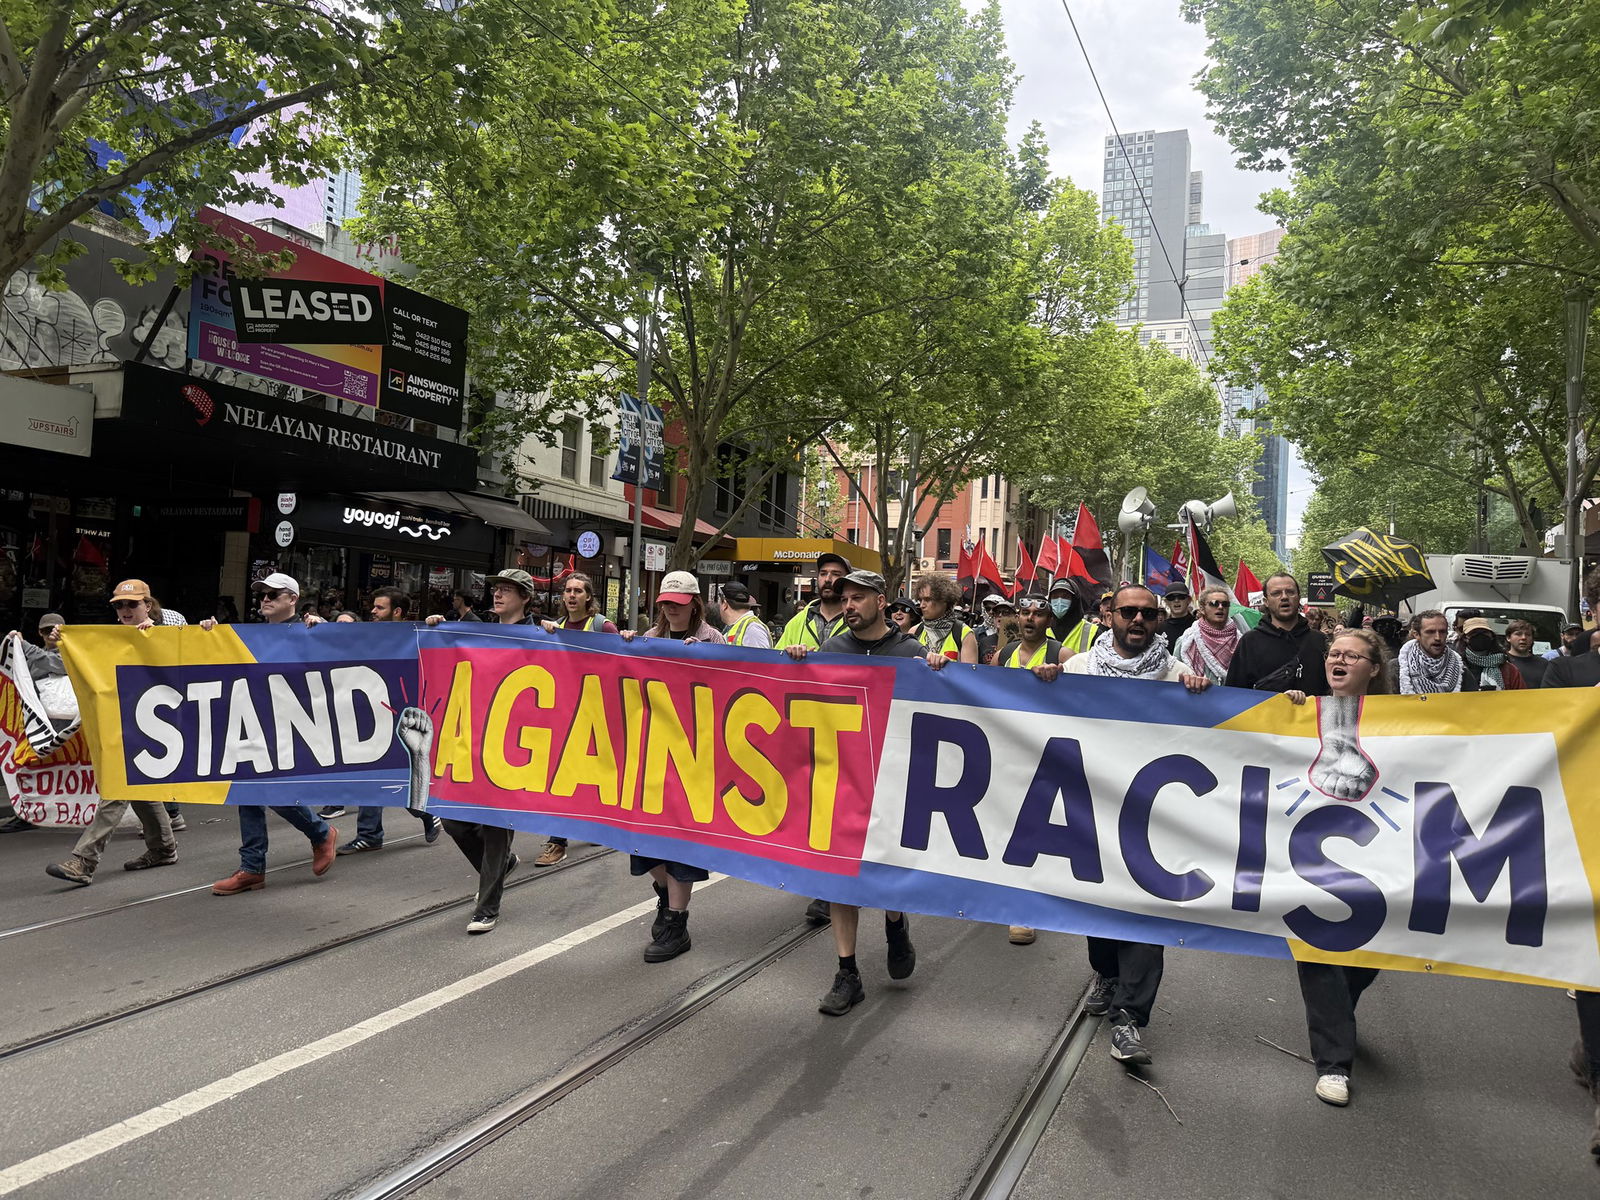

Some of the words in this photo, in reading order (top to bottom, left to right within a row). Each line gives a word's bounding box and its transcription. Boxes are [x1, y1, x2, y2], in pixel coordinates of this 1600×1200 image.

[203, 280, 232, 307] FO
[240, 287, 373, 322] LEASED
[393, 307, 410, 319] CALL
[411, 313, 421, 323] OR
[422, 317, 438, 329] TEXT
[392, 331, 406, 341] Josh
[415, 331, 430, 341] 0422
[430, 337, 440, 345] 510
[392, 339, 412, 352] Zelman
[216, 347, 250, 365] WELCOME
[407, 374, 459, 397] AINSWORTH
[406, 385, 452, 406] PROPERTY
[622, 412, 633, 422] ONLY
[626, 420, 636, 430] THIS
[32, 421, 74, 436] UPSTAIRS
[624, 428, 633, 437] CITY
[645, 421, 656, 430] ONLY
[223, 402, 323, 444] NELAYAN
[326, 426, 442, 469] RESTAURANT
[647, 437, 656, 446] CITY
[649, 430, 659, 439] THIS
[342, 507, 400, 530] yoyogi
[774, 550, 826, 559] McDonald'
[16, 770, 99, 795] COLON
[55, 802, 97, 826] BAC
[133, 665, 393, 778] STAND
[433, 660, 863, 852] AGAINST
[899, 712, 1548, 952] RACISM
